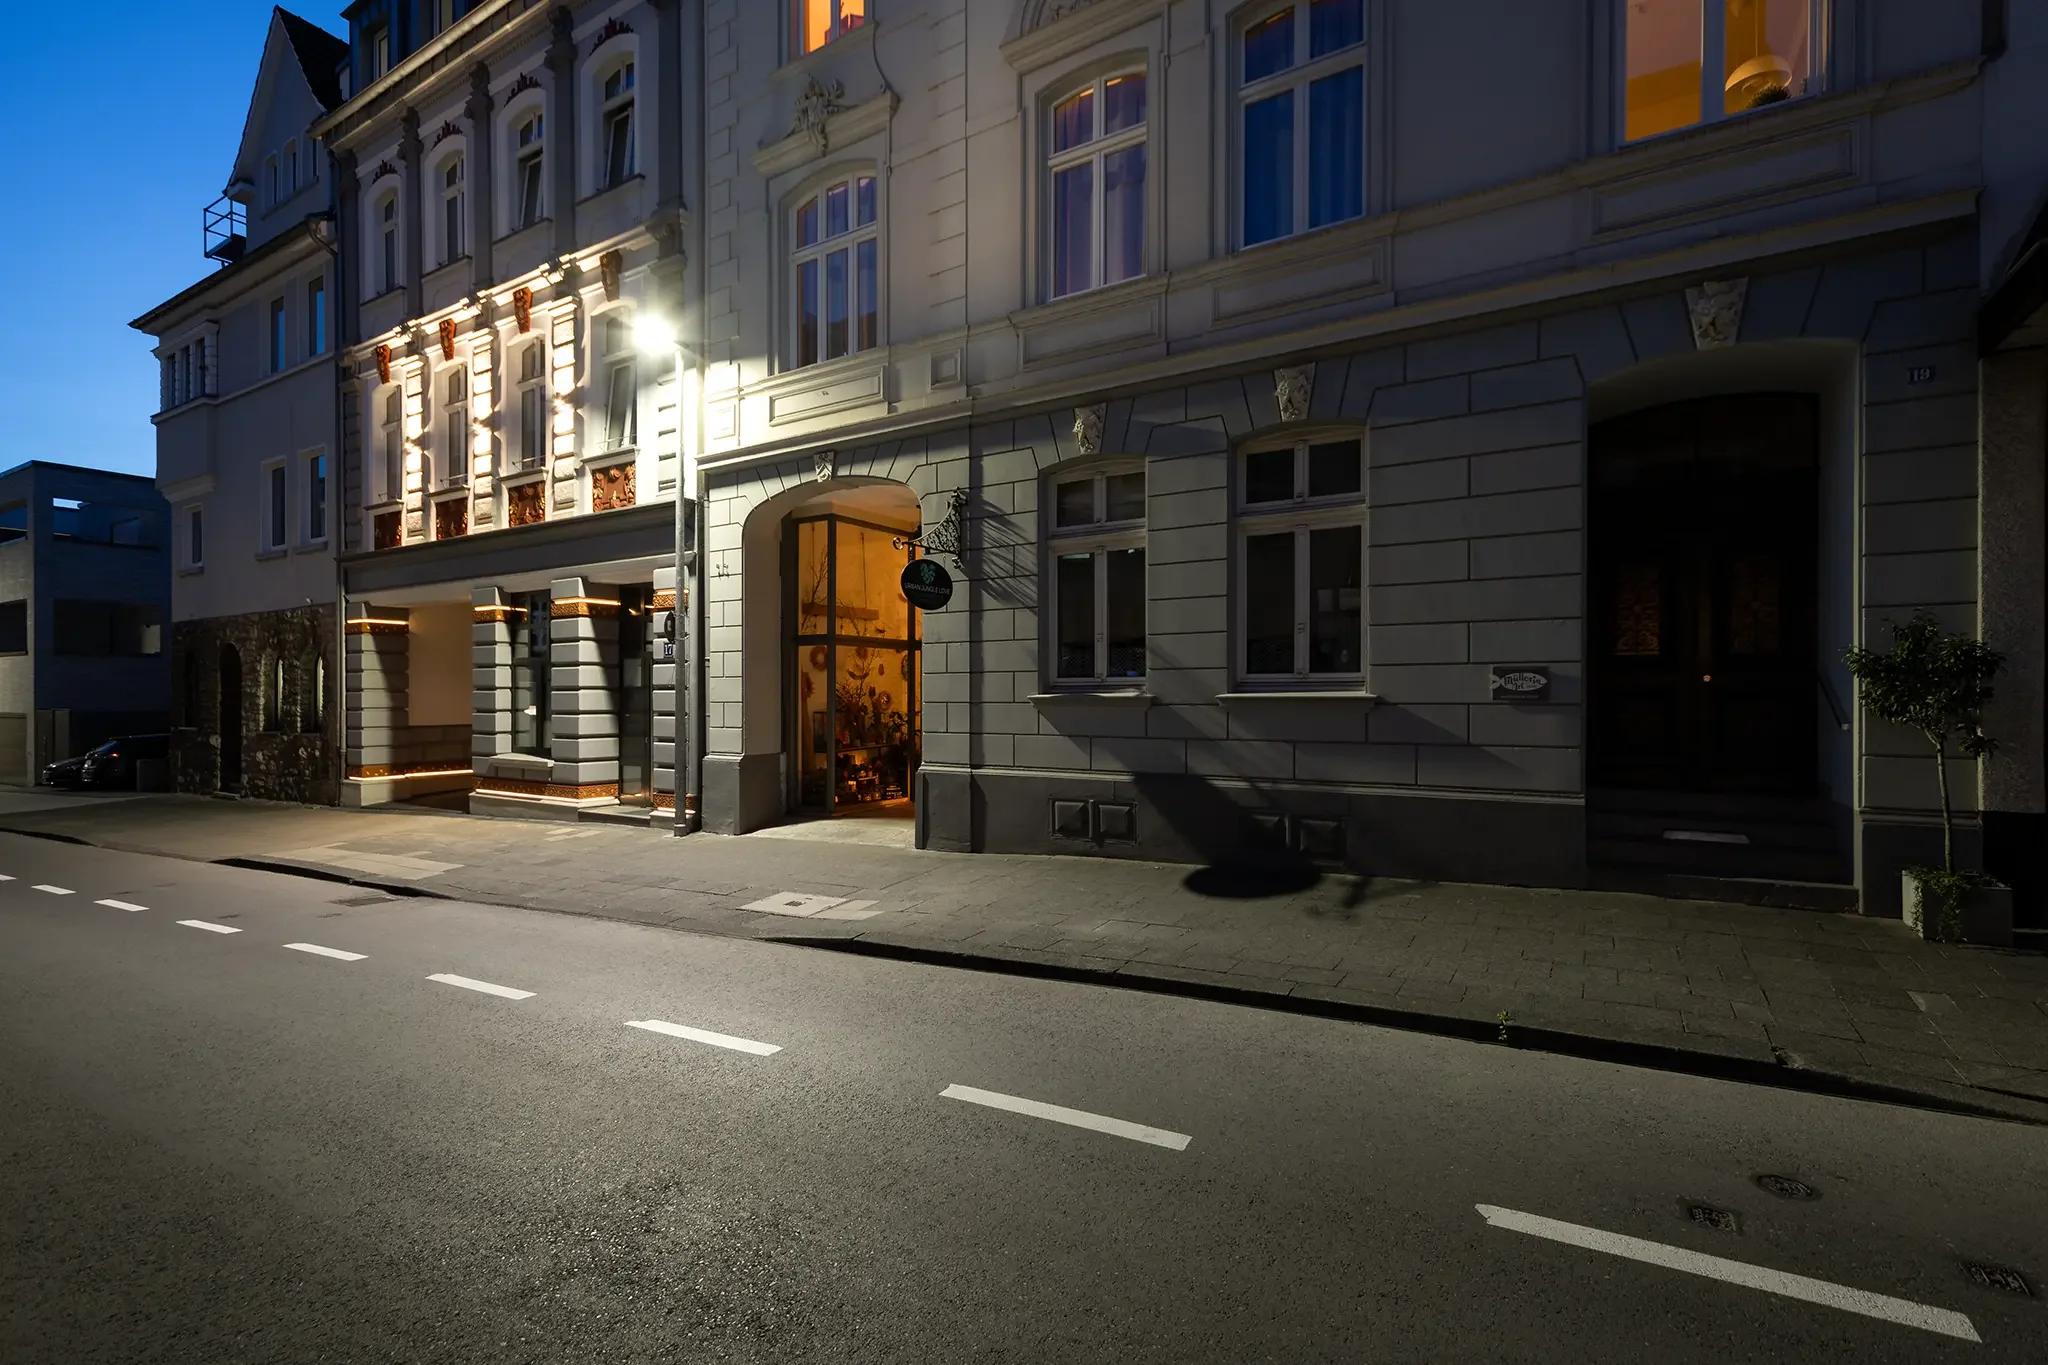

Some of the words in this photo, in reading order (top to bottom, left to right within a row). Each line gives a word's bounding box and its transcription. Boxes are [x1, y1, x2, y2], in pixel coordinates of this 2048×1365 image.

[1913, 368, 1930, 381] 19
[904, 582, 920, 591] URBAN
[920, 585, 938, 594] JUNGLE
[939, 587, 951, 595] LOVE
[664, 644, 673, 655] 17
